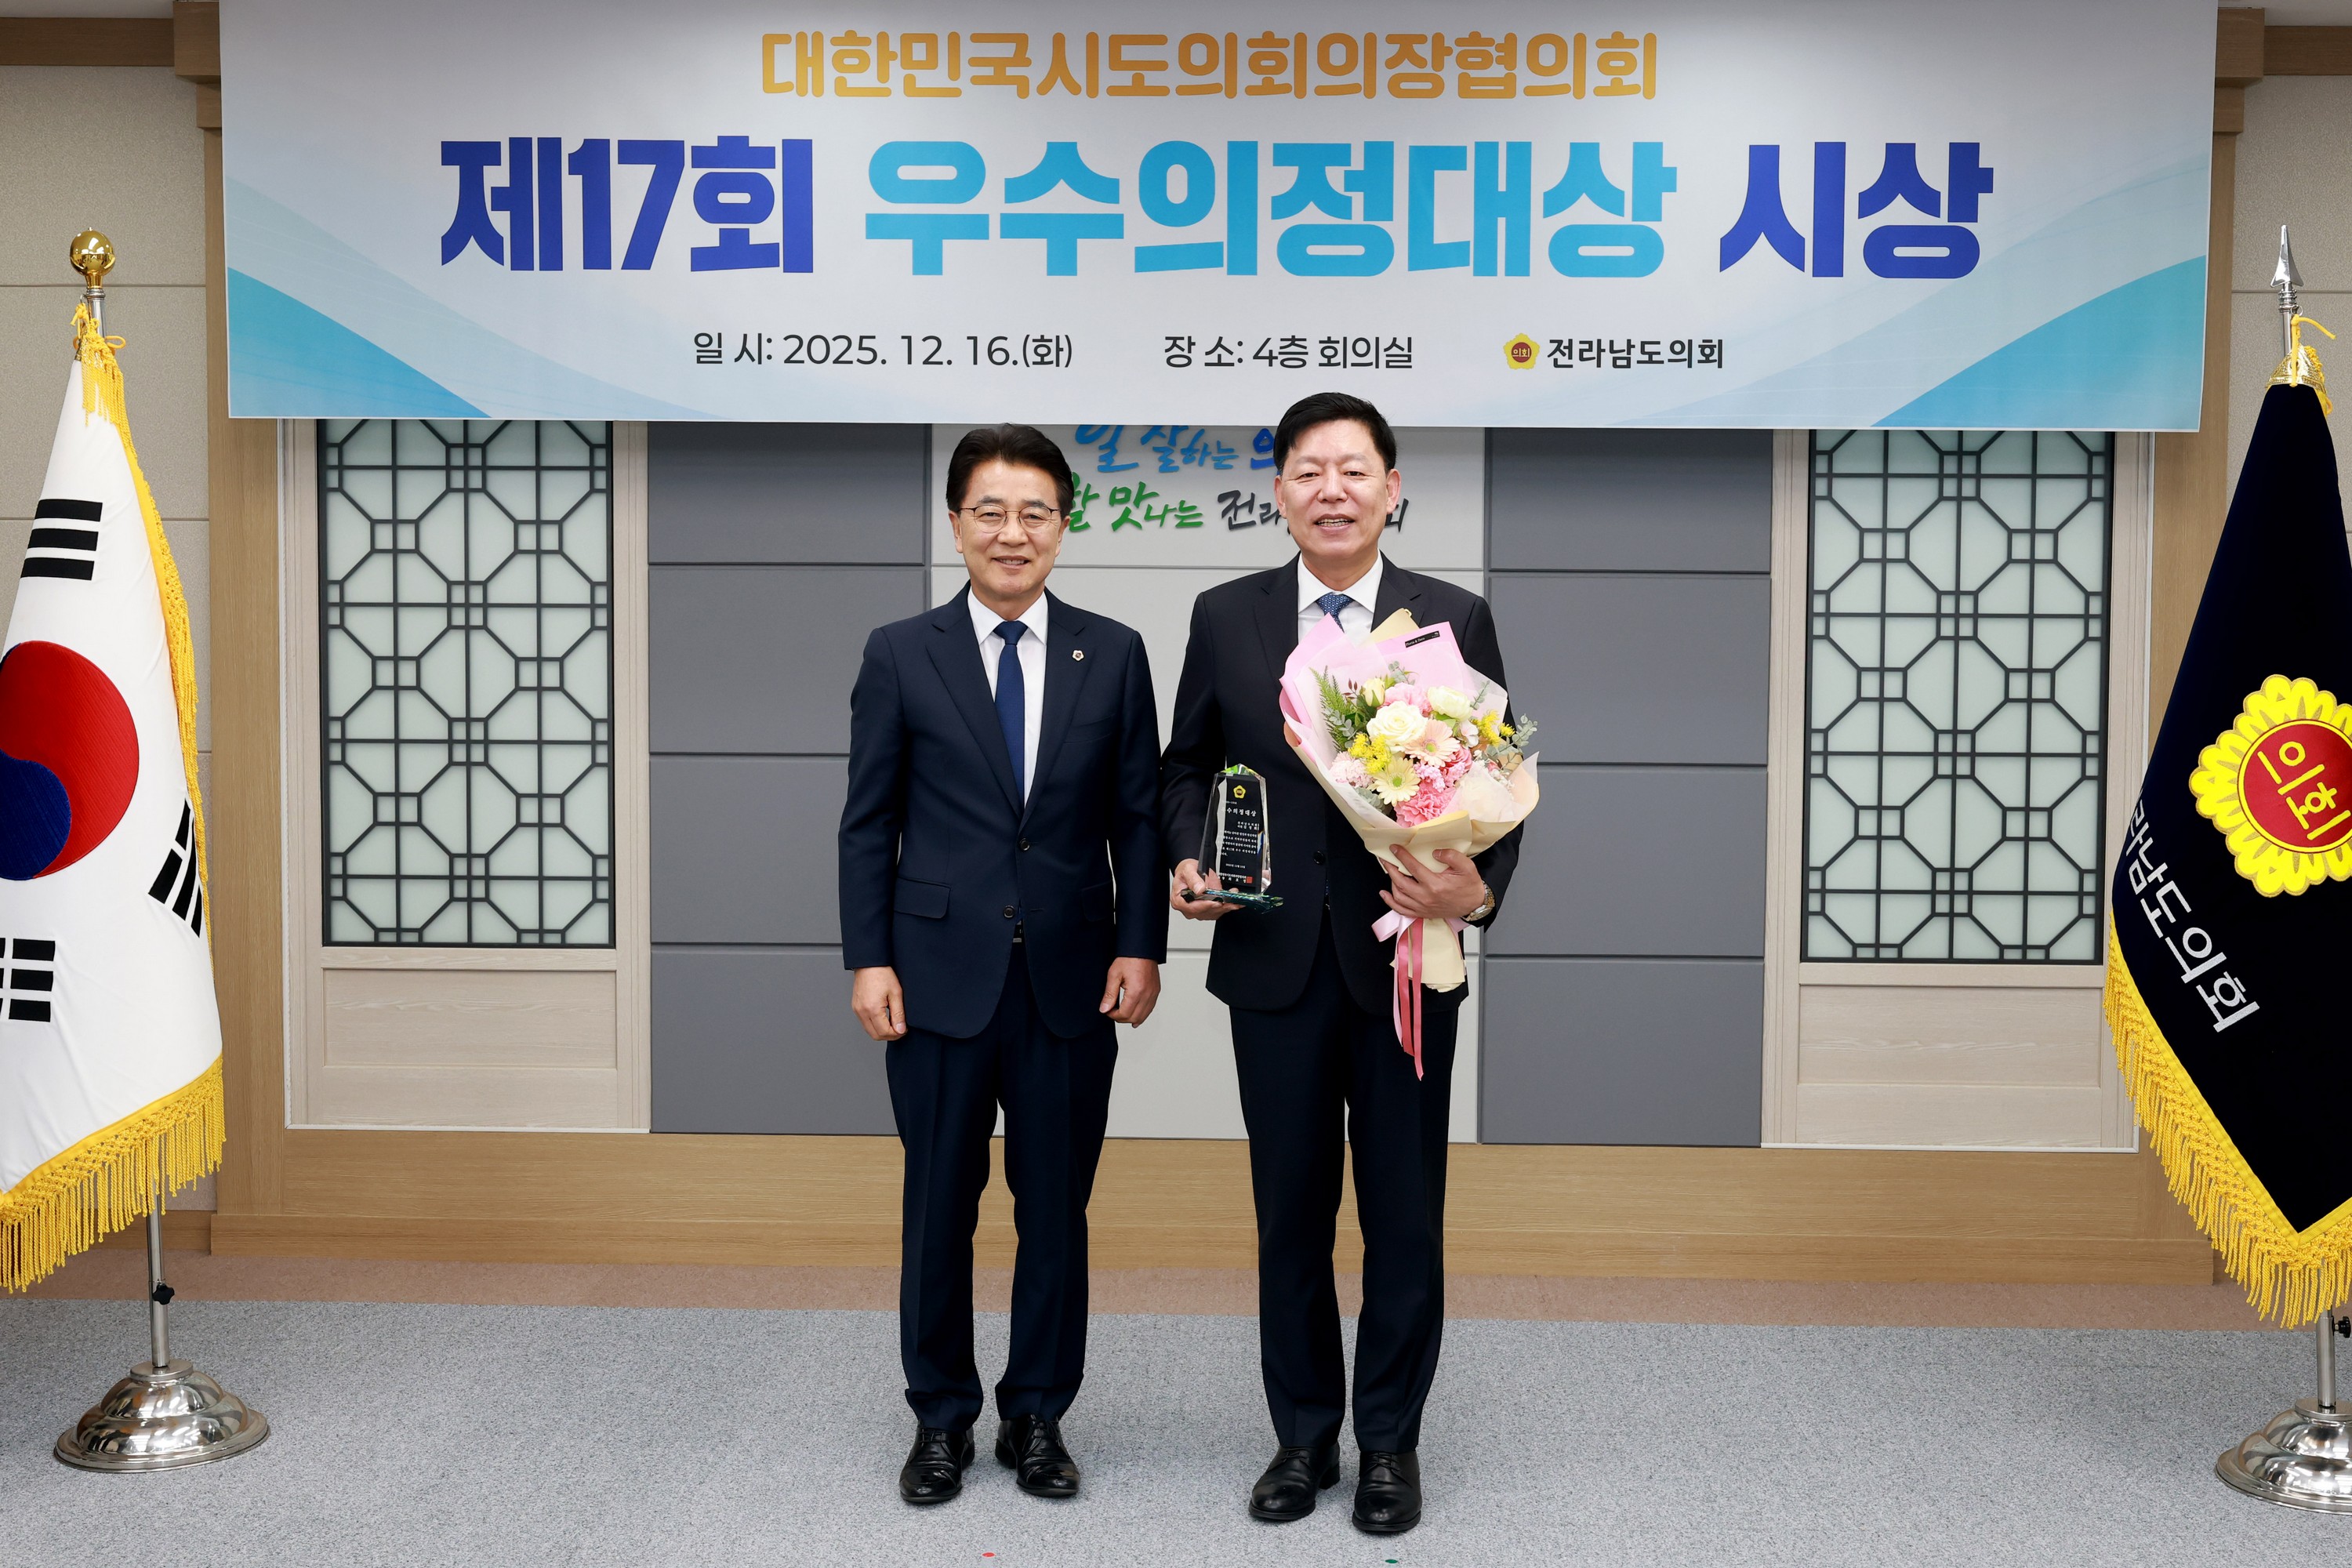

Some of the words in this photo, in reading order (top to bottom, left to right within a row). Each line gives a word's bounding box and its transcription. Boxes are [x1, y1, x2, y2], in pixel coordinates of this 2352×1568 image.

[761, 29, 1659, 100] 대한민국시도의회의장협의회
[441, 136, 814, 274] 제17회
[865, 140, 1677, 278] 우수의정대상
[1719, 141, 1994, 279] 시상
[694, 332, 723, 365] 일
[734, 332, 773, 365] 시:
[782, 334, 887, 365] 2025.
[900, 335, 953, 366] 12.
[966, 334, 1073, 368] 16.(화)
[1164, 336, 1195, 368] 장
[1203, 336, 1243, 367] 소:
[1252, 335, 1308, 369] 4층
[1318, 336, 1413, 369] 회의실
[1547, 338, 1723, 369] 전라남도의회
[1109, 481, 1204, 532] 맛나는
[2256, 741, 2352, 840] 의회
[2125, 787, 2260, 1033] 라남도의회
